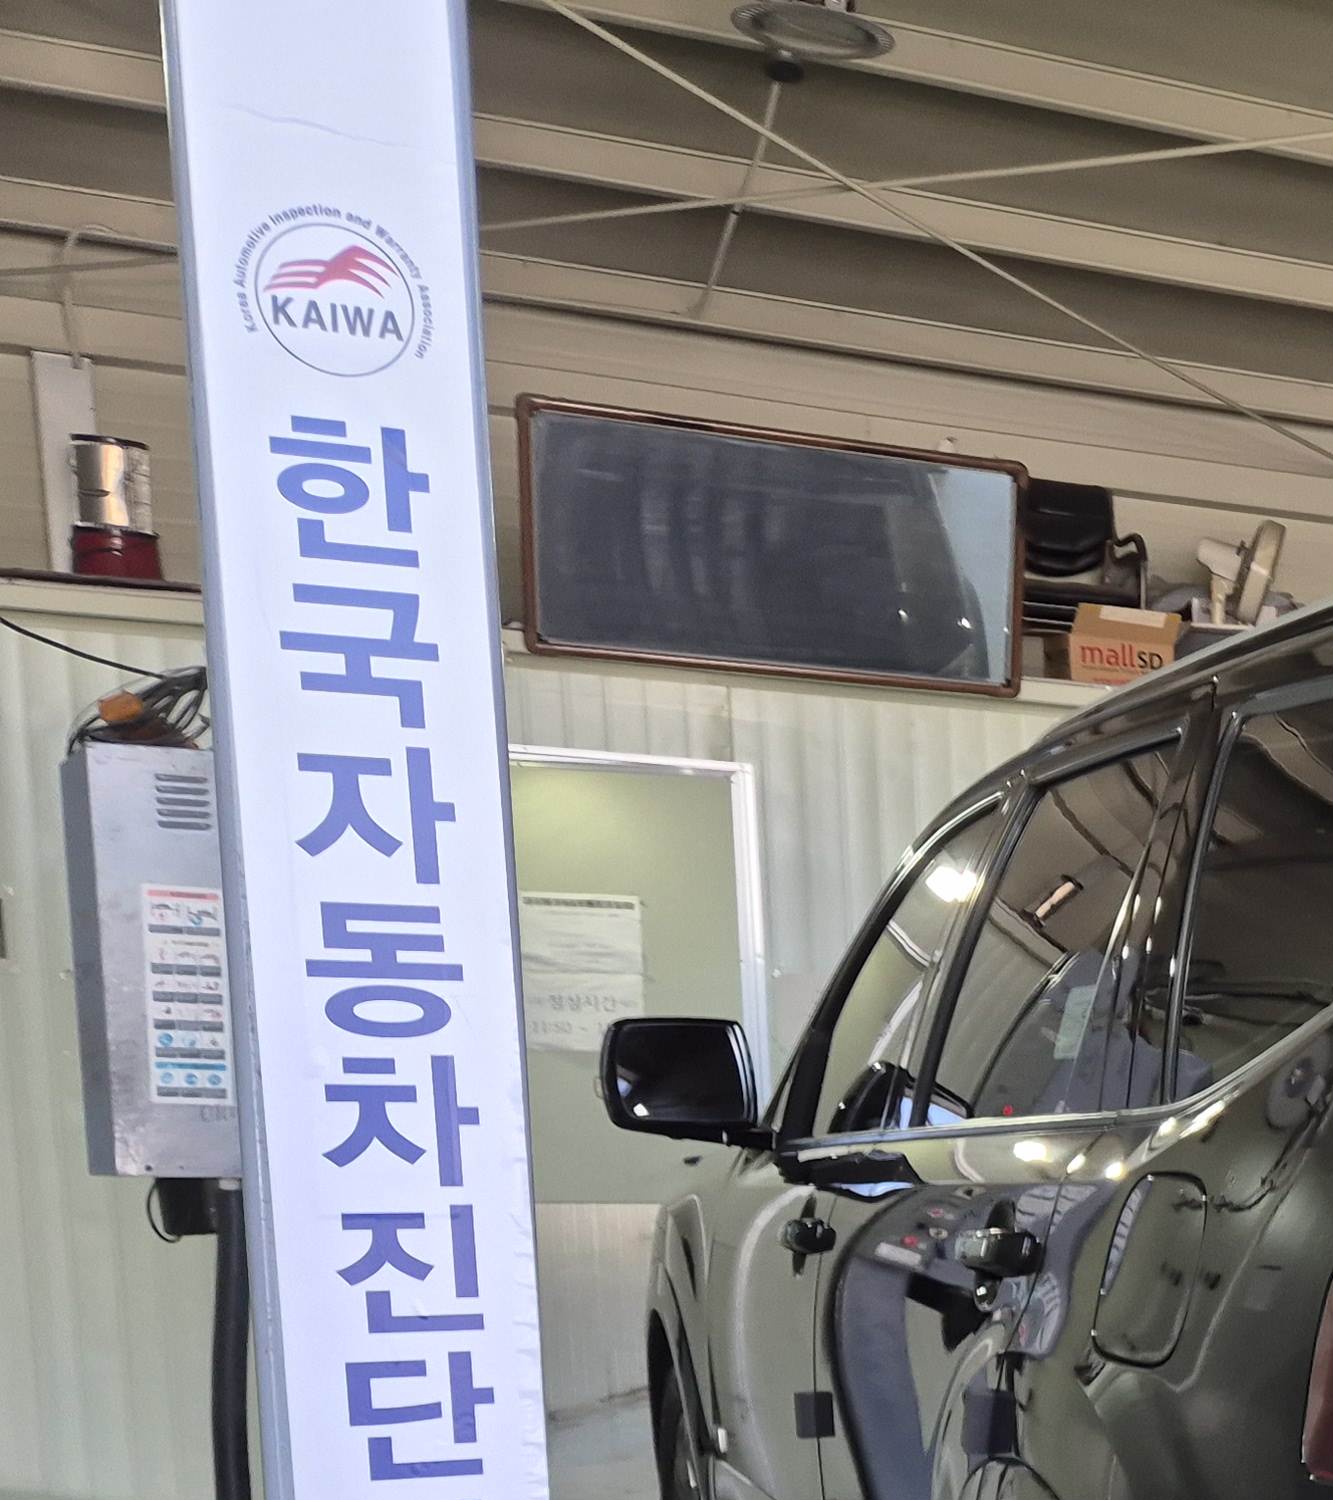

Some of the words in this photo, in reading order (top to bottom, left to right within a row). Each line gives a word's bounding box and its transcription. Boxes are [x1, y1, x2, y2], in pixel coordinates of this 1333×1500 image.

[268, 203, 342, 226] Inspection
[345, 211, 373, 230] and
[233, 221, 271, 289] Automotive
[375, 223, 422, 280] Warranty
[236, 291, 258, 334] Korea
[270, 294, 404, 342] KAIWA
[414, 284, 436, 361] Association
